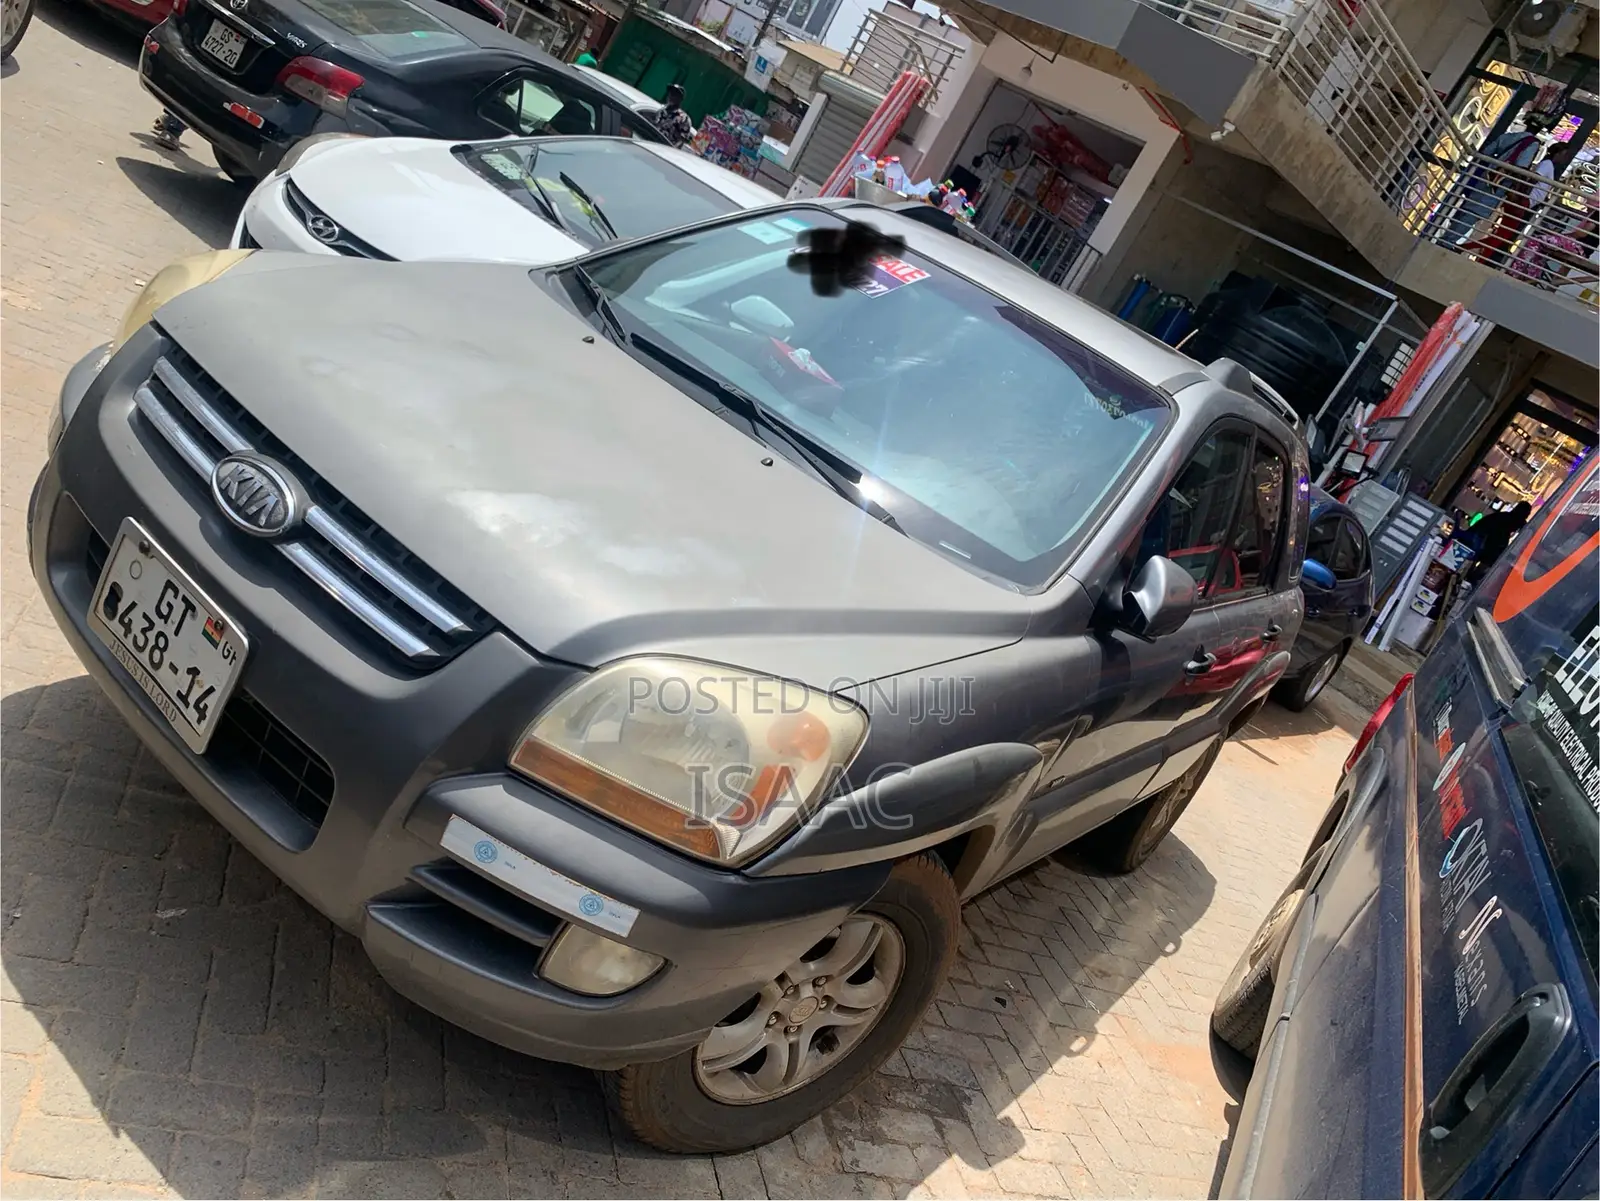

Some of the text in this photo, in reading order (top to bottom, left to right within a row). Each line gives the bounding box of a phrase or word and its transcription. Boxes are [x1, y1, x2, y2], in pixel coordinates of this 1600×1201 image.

[204, 35, 238, 65] 4727-20
[220, 28, 234, 44] GS
[219, 464, 278, 528] KIA
[155, 578, 196, 637] GT
[103, 581, 216, 725] 438-14
[109, 640, 177, 722] JESUS IS LORD
[1560, 728, 1593, 780] ELECTRICAL
[1458, 895, 1502, 1007] Nexans
